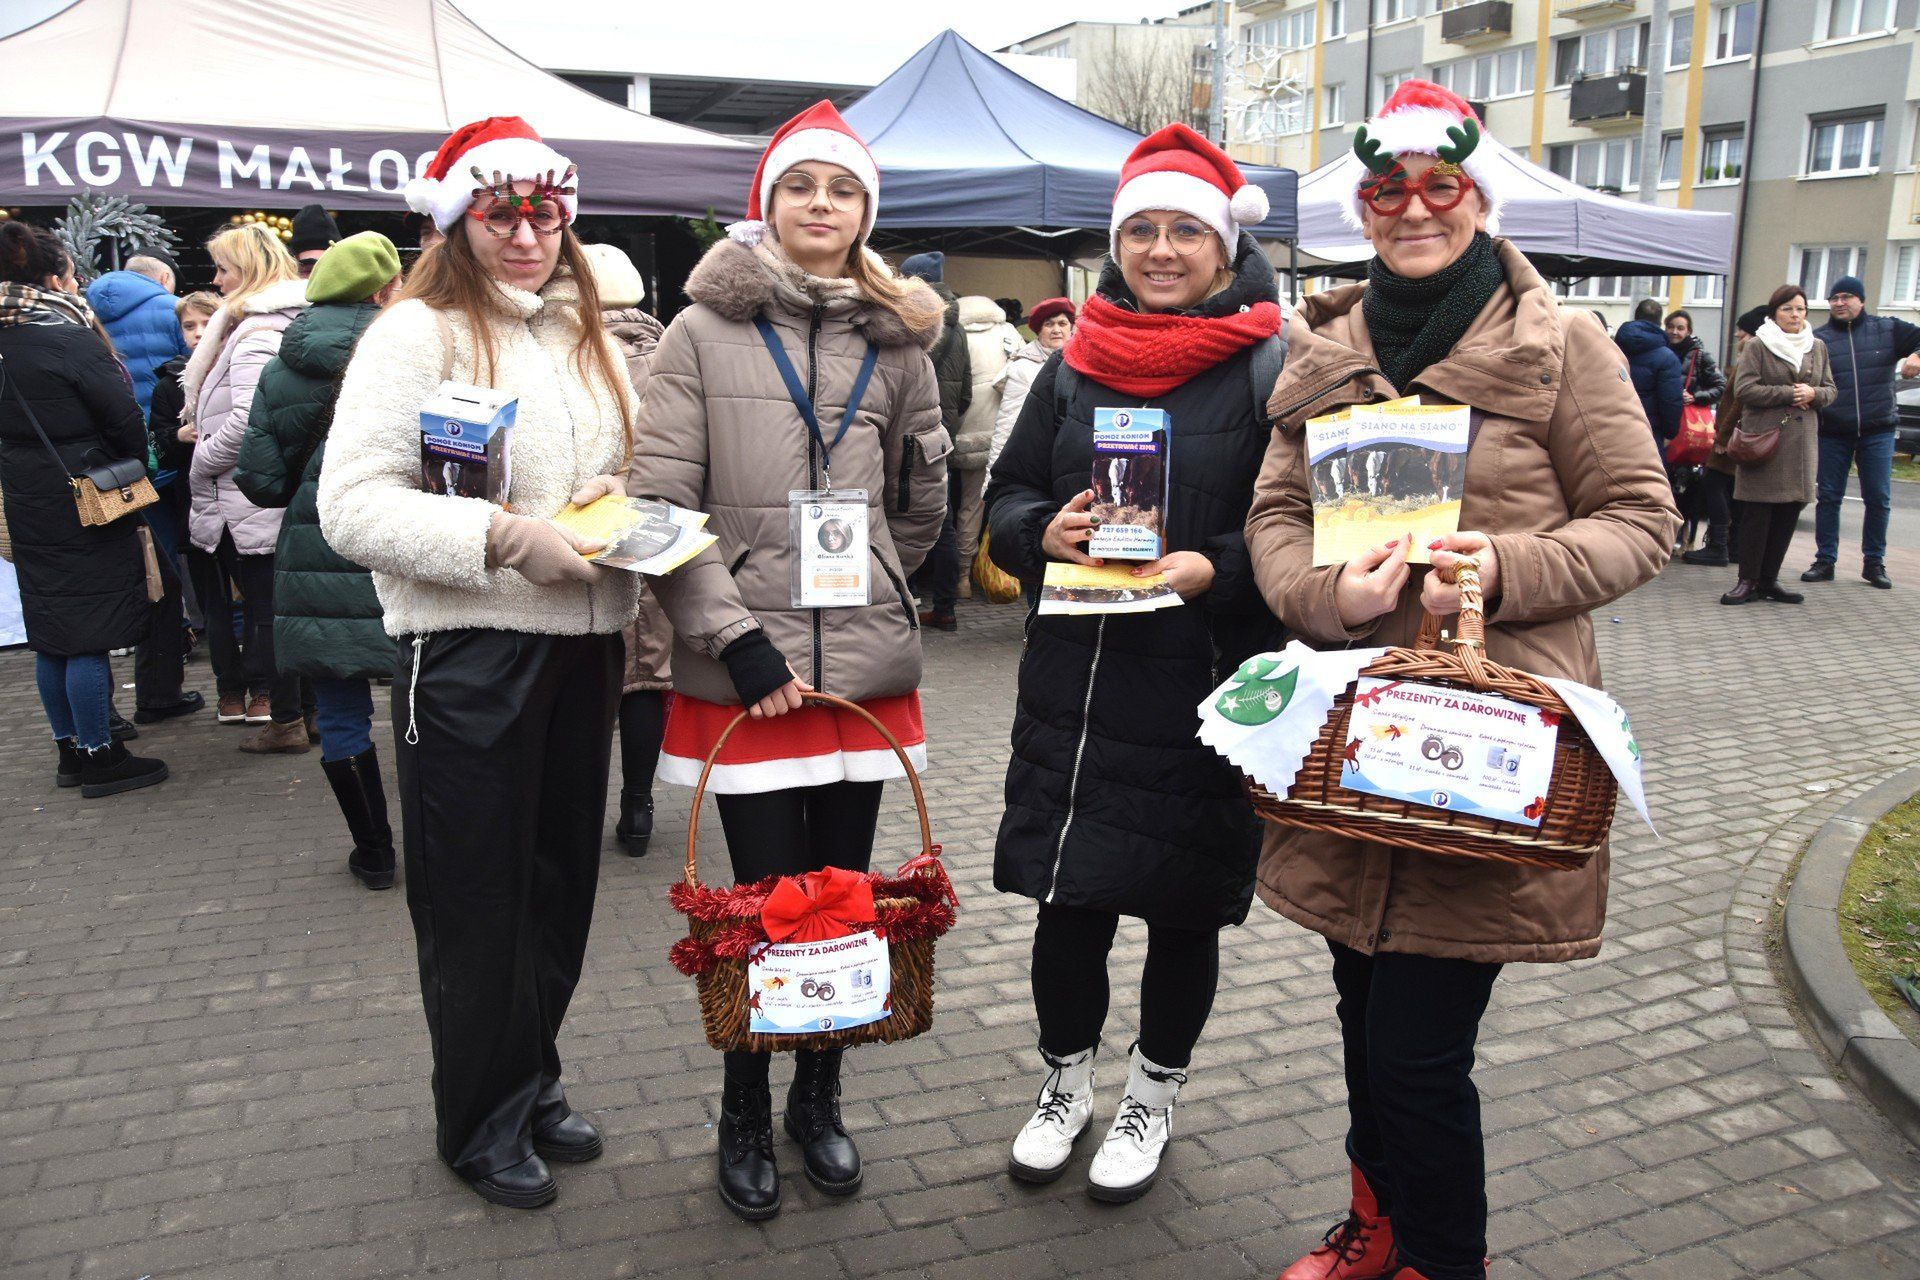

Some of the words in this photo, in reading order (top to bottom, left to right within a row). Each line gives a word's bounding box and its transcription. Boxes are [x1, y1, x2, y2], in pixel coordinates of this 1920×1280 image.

[22, 131, 194, 188] KGW
[1400, 422, 1415, 431] NA
[1386, 689, 1442, 706] PREZENTY
[1444, 698, 1459, 710] ZA
[1462, 701, 1527, 726] DAROWIZNĘ
[767, 948, 805, 957] PREZENTY
[808, 948, 821, 956] ZA
[822, 937, 867, 954] DAROWIZNĘ
